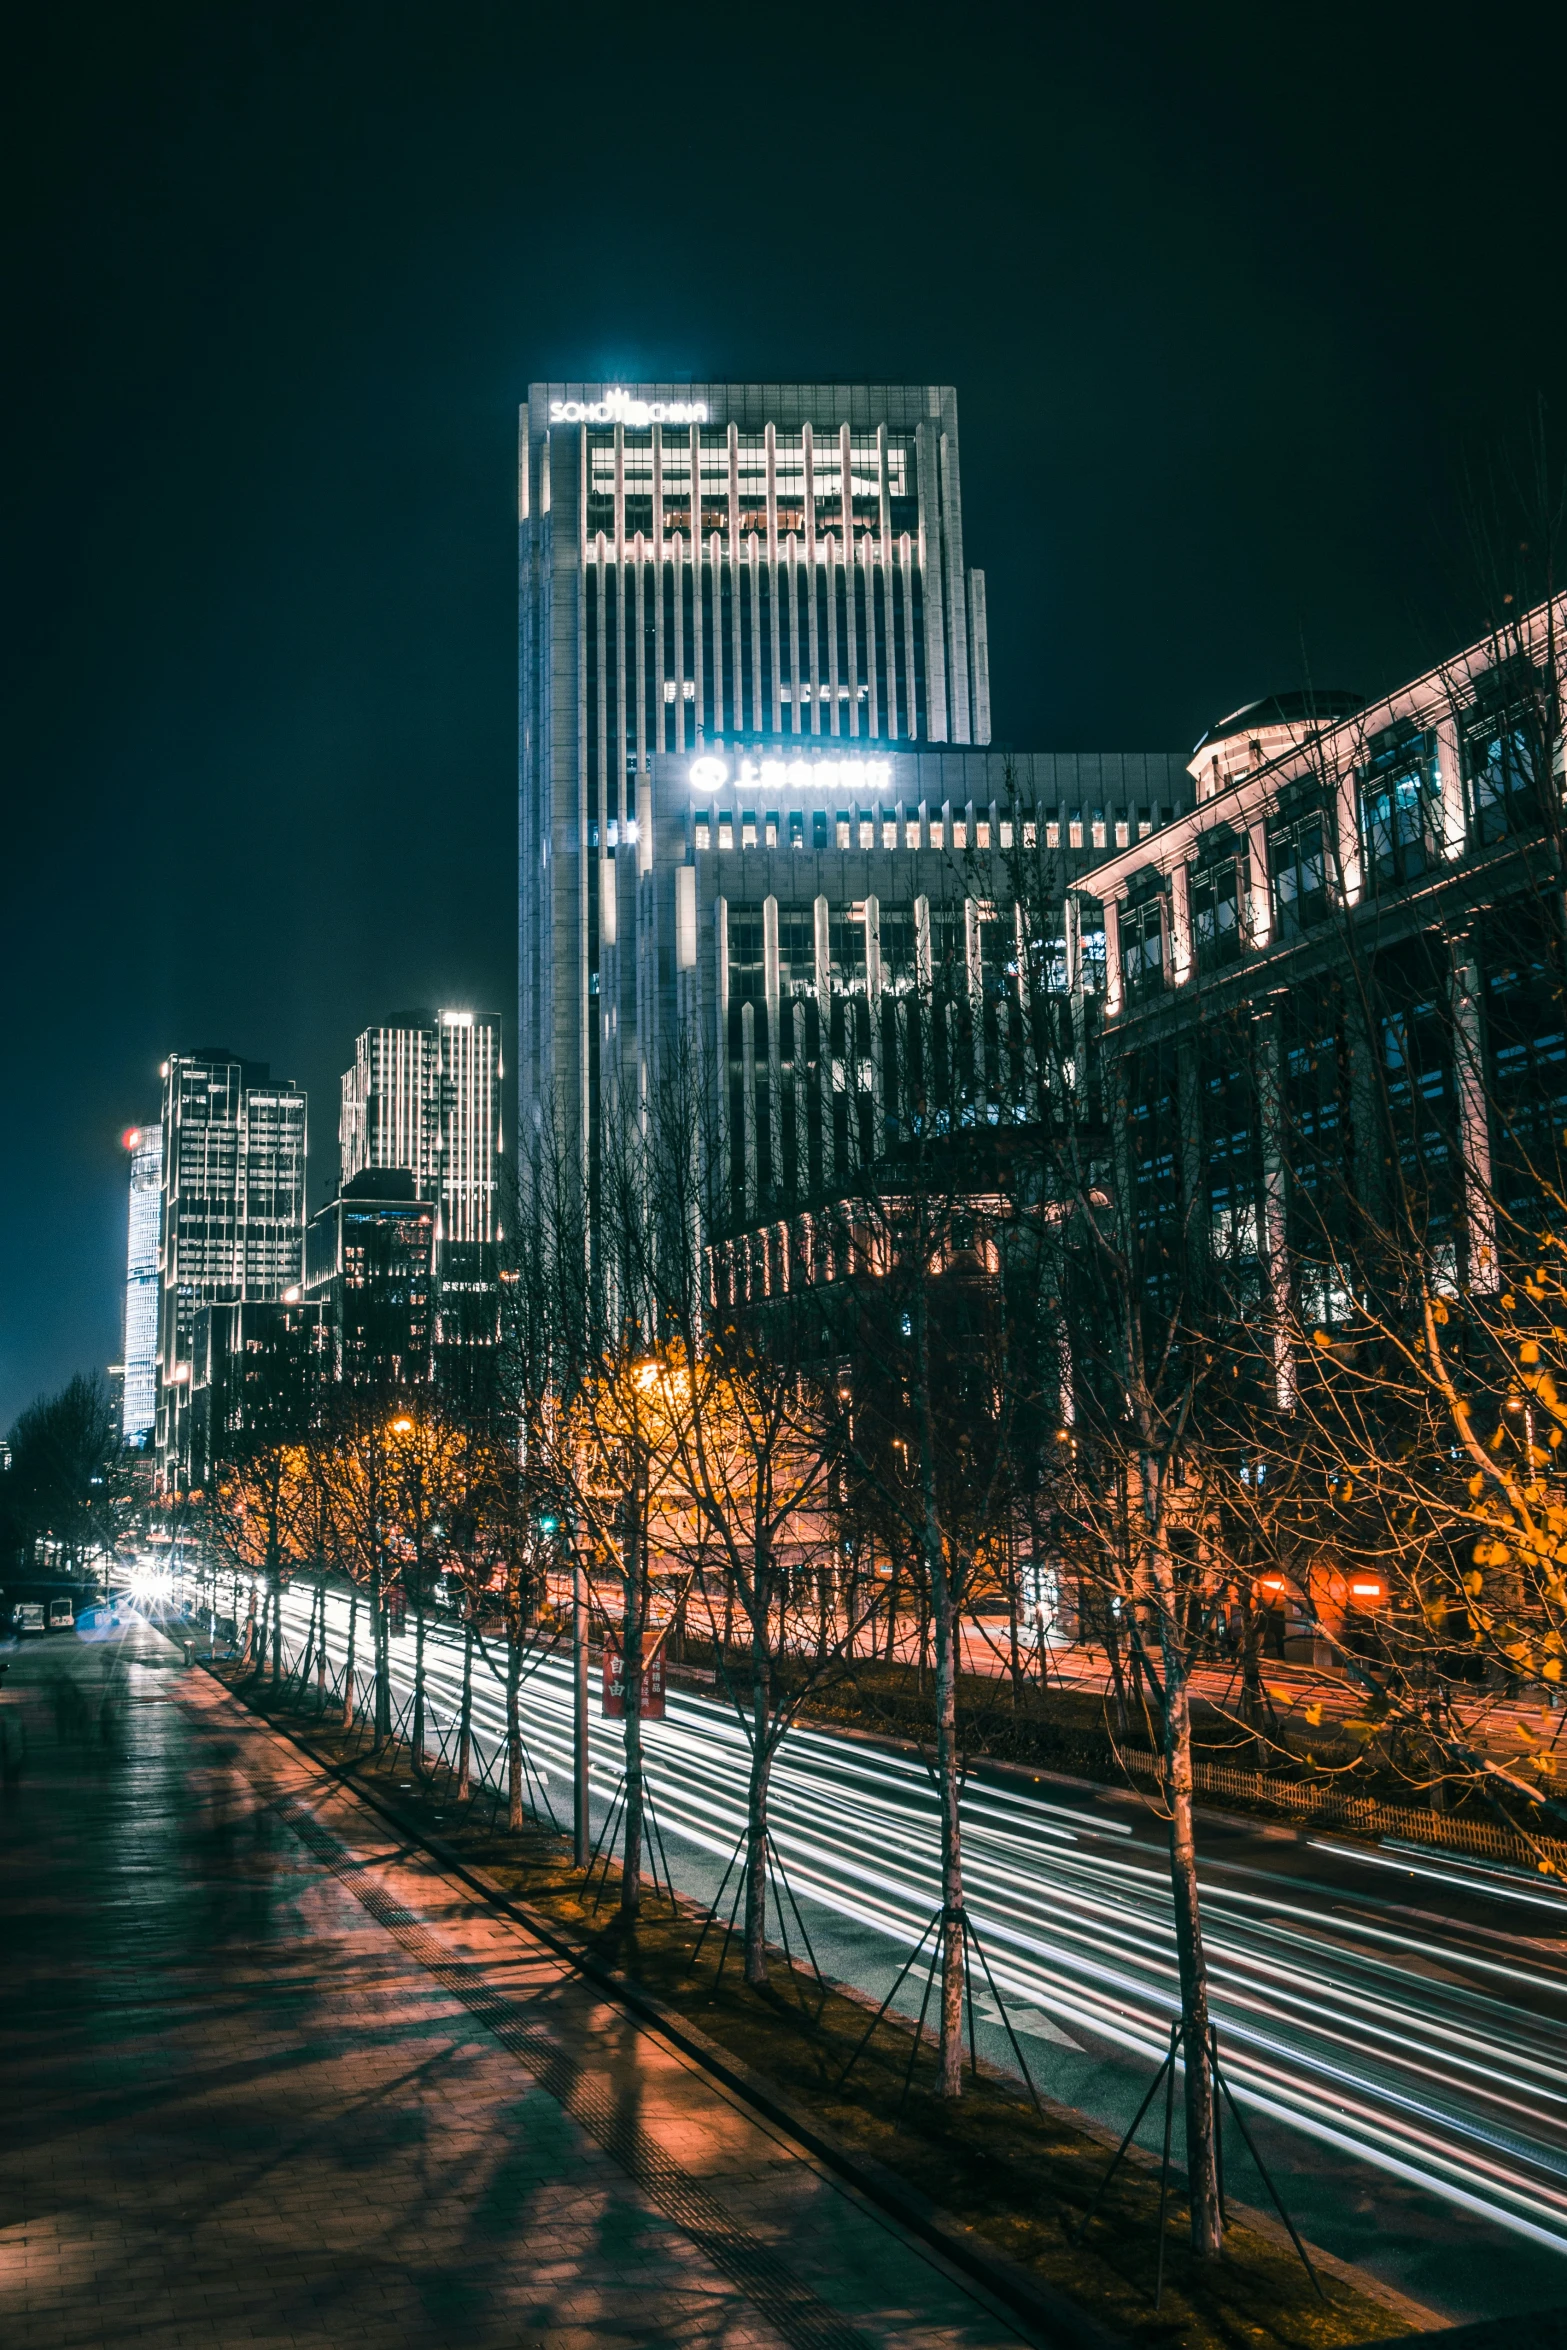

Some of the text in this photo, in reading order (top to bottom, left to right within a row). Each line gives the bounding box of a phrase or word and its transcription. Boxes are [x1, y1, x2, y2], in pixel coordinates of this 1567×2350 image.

[550, 402, 613, 423] SOHO
[648, 402, 708, 423] CHINA
[608, 1656, 625, 1697] 自由
